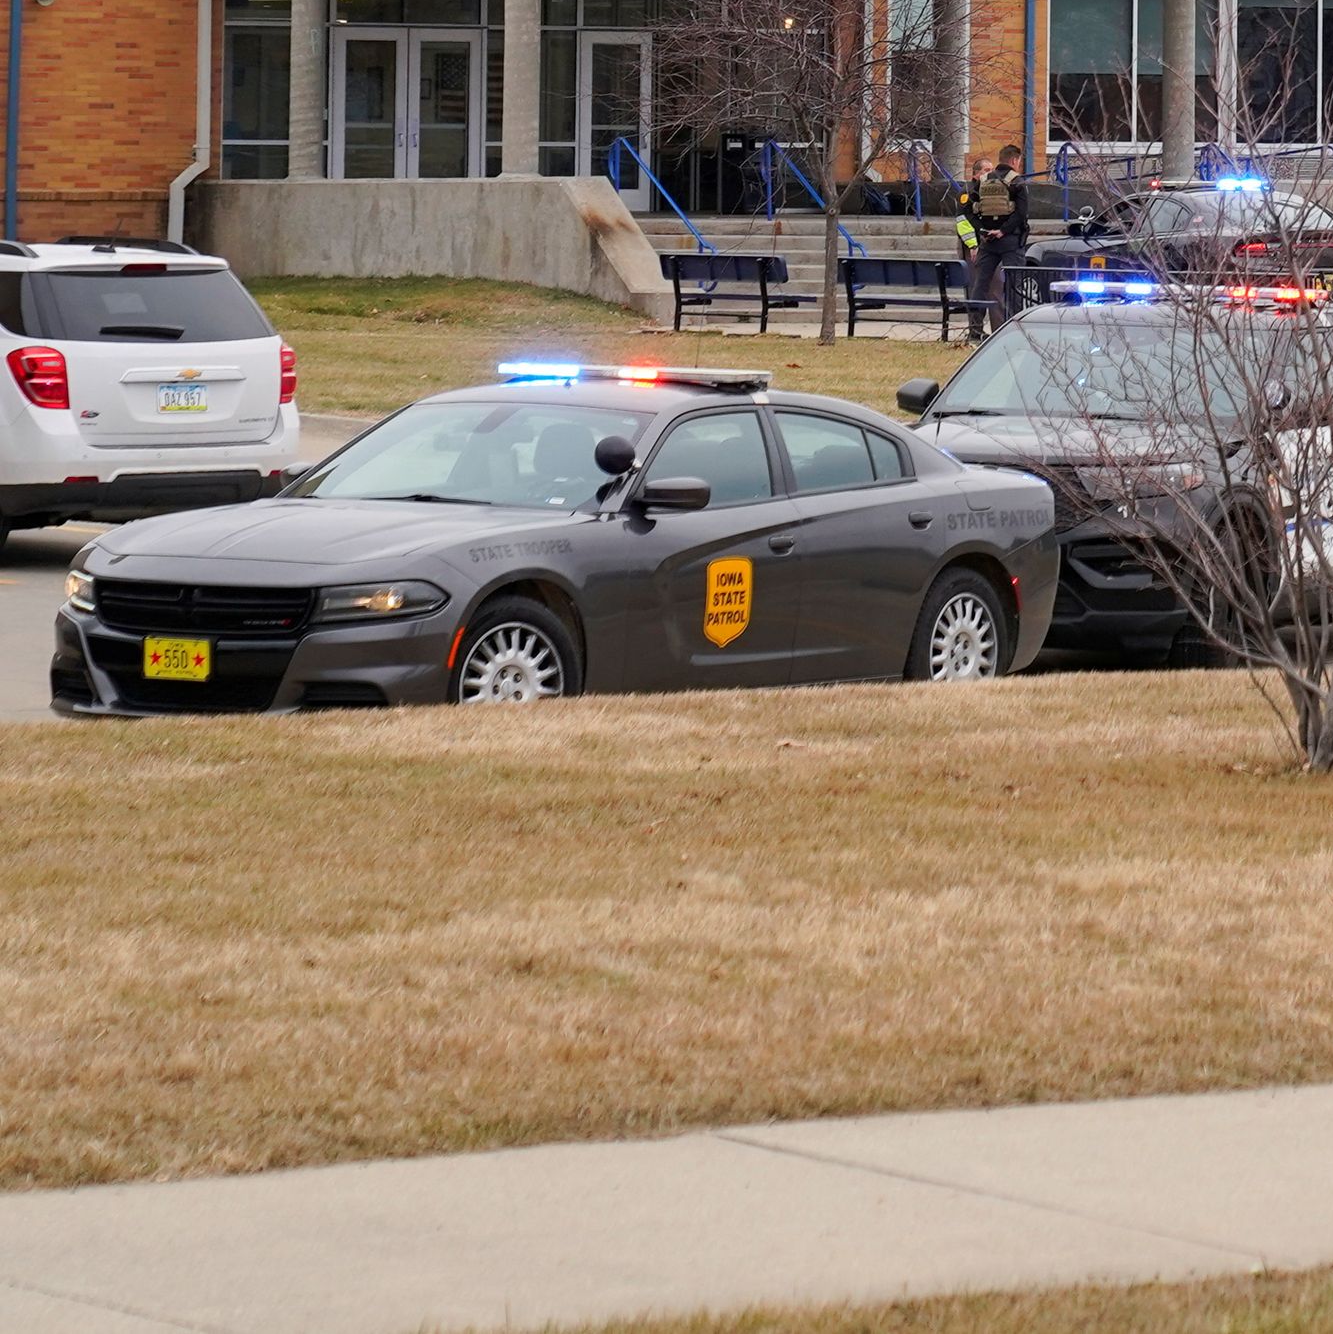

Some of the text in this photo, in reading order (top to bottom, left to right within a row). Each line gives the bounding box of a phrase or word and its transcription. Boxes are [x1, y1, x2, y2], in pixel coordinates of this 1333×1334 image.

[184, 392, 201, 406] 957
[946, 512, 997, 531] STATE
[469, 538, 573, 563] STATE TROOPER
[716, 573, 744, 587] IOWA
[712, 590, 746, 606] STATE
[706, 610, 746, 626] PATROL
[164, 649, 188, 669] 550
